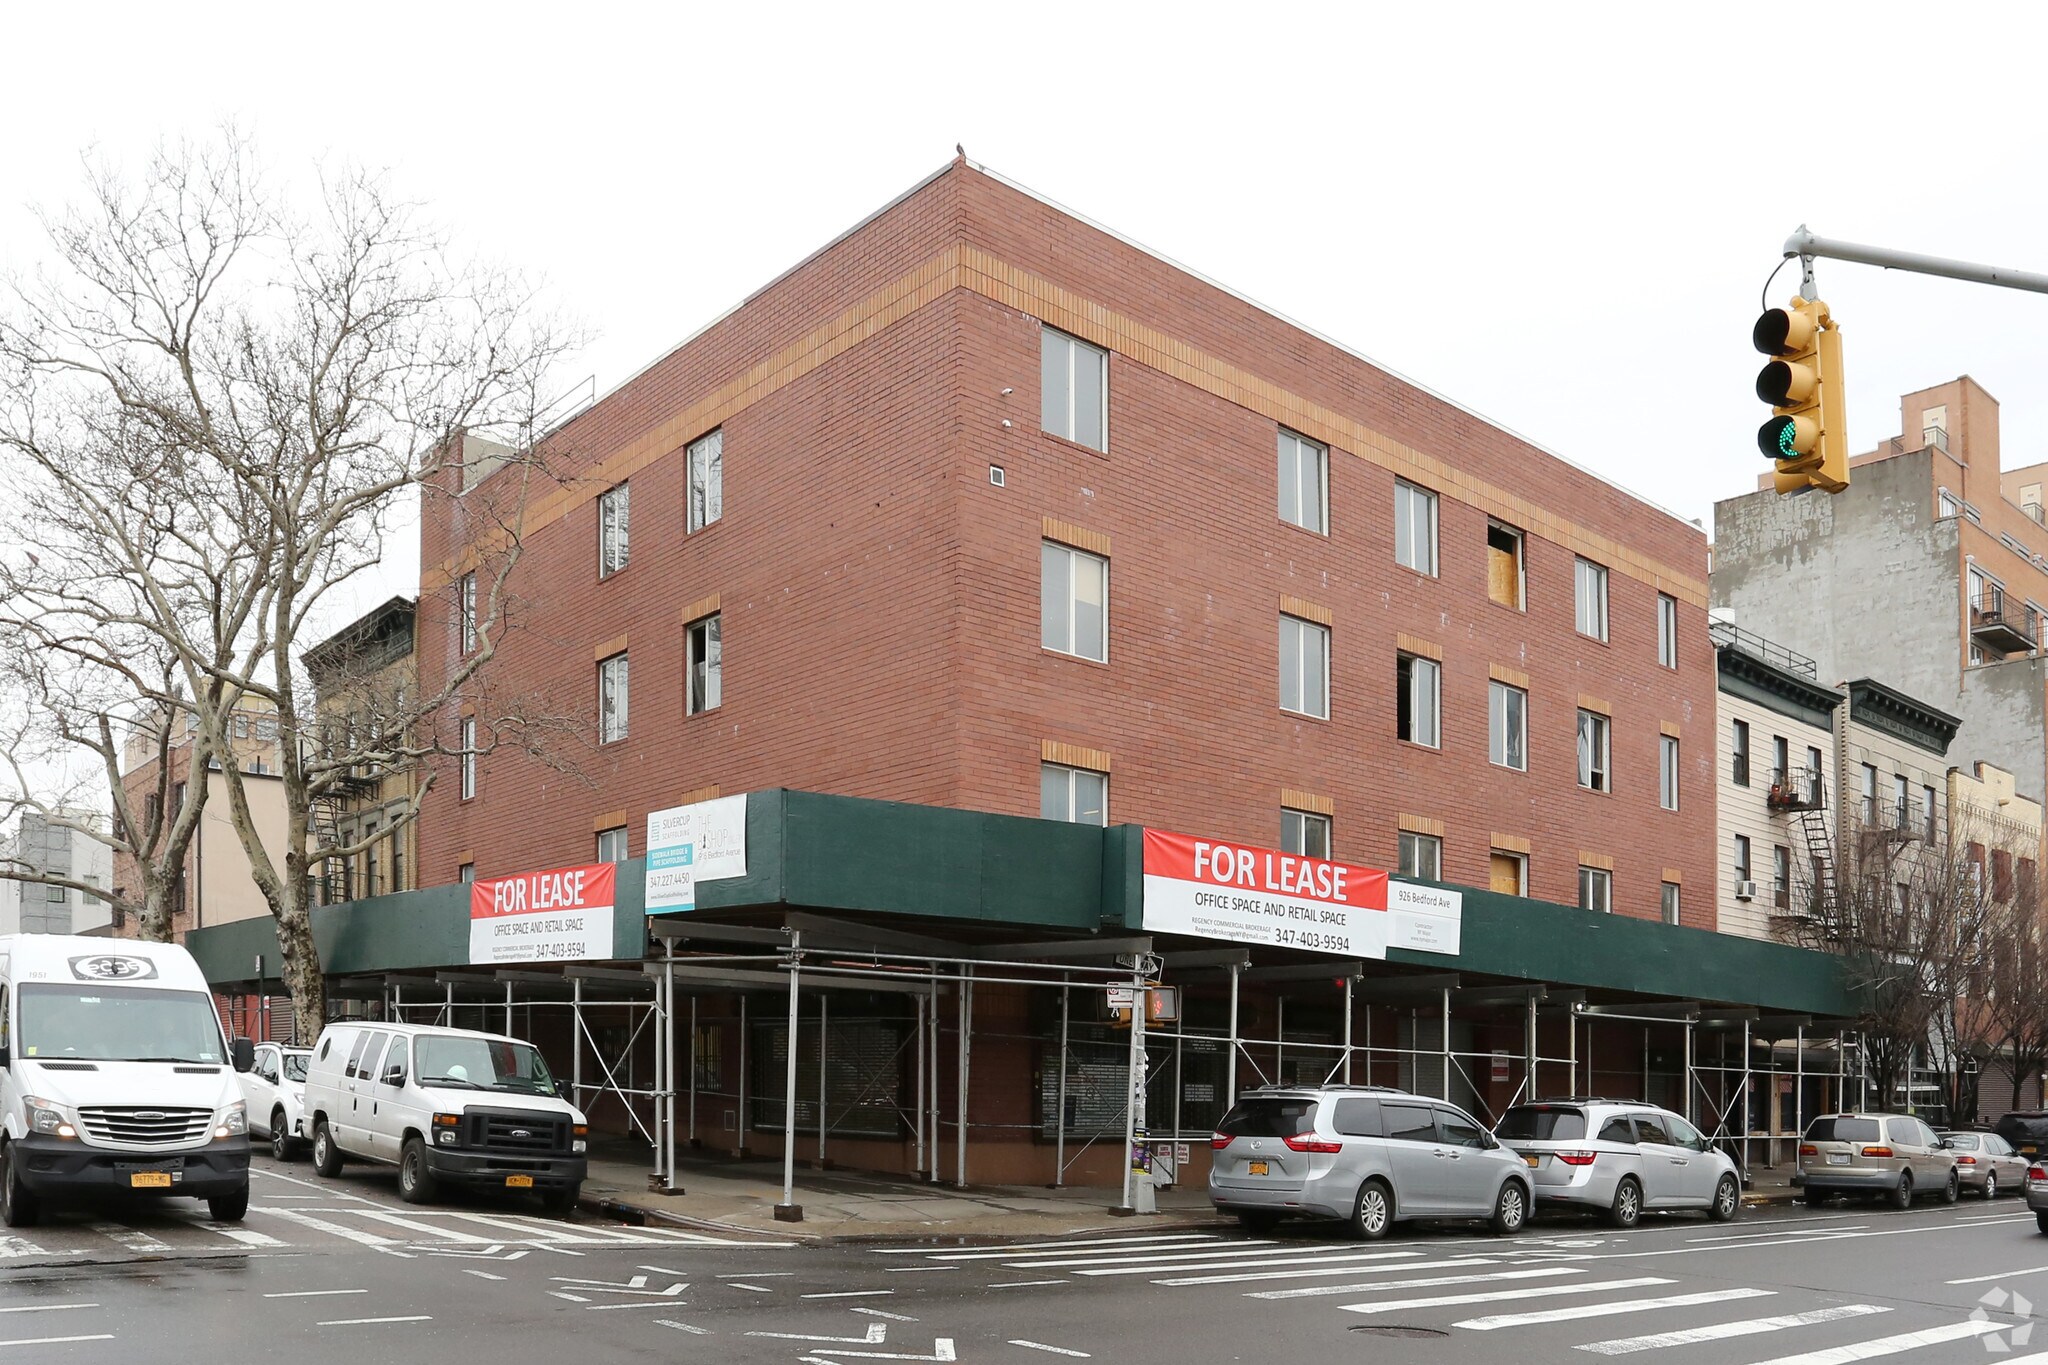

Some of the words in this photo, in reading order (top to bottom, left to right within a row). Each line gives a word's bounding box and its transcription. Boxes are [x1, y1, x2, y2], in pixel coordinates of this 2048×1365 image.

[662, 815, 691, 829] SILVERCUP
[698, 815, 711, 834] THE
[662, 829, 690, 840] SCAFFOLDING
[650, 872, 690, 888] 347.227.4450
[1194, 841, 1256, 887] FOR
[1265, 853, 1348, 901] LEASE
[494, 878, 527, 913] FOR
[531, 870, 585, 910] LEASE
[1398, 890, 1411, 902] 926
[1412, 892, 1437, 906] Bedford
[1438, 897, 1450, 908] Ave
[1195, 892, 1229, 909] OFFICE
[1232, 897, 1260, 914] SPACE
[1264, 902, 1285, 917] AND
[1288, 905, 1317, 922] RETAIL
[1320, 910, 1346, 926] SPACE
[494, 923, 511, 936] OFFICE
[512, 922, 529, 935] SPACE
[530, 921, 544, 934] AND
[544, 919, 564, 933] RETAIL
[565, 918, 584, 931] SPACE
[1192, 917, 1213, 925] REGENCY
[1213, 919, 1245, 930] COMMERCIAL
[1245, 923, 1271, 933] BROKERAGE
[1275, 928, 1350, 951] 347-403-9594
[536, 942, 586, 959] 347-403-9594
[29, 971, 47, 979] 1951
